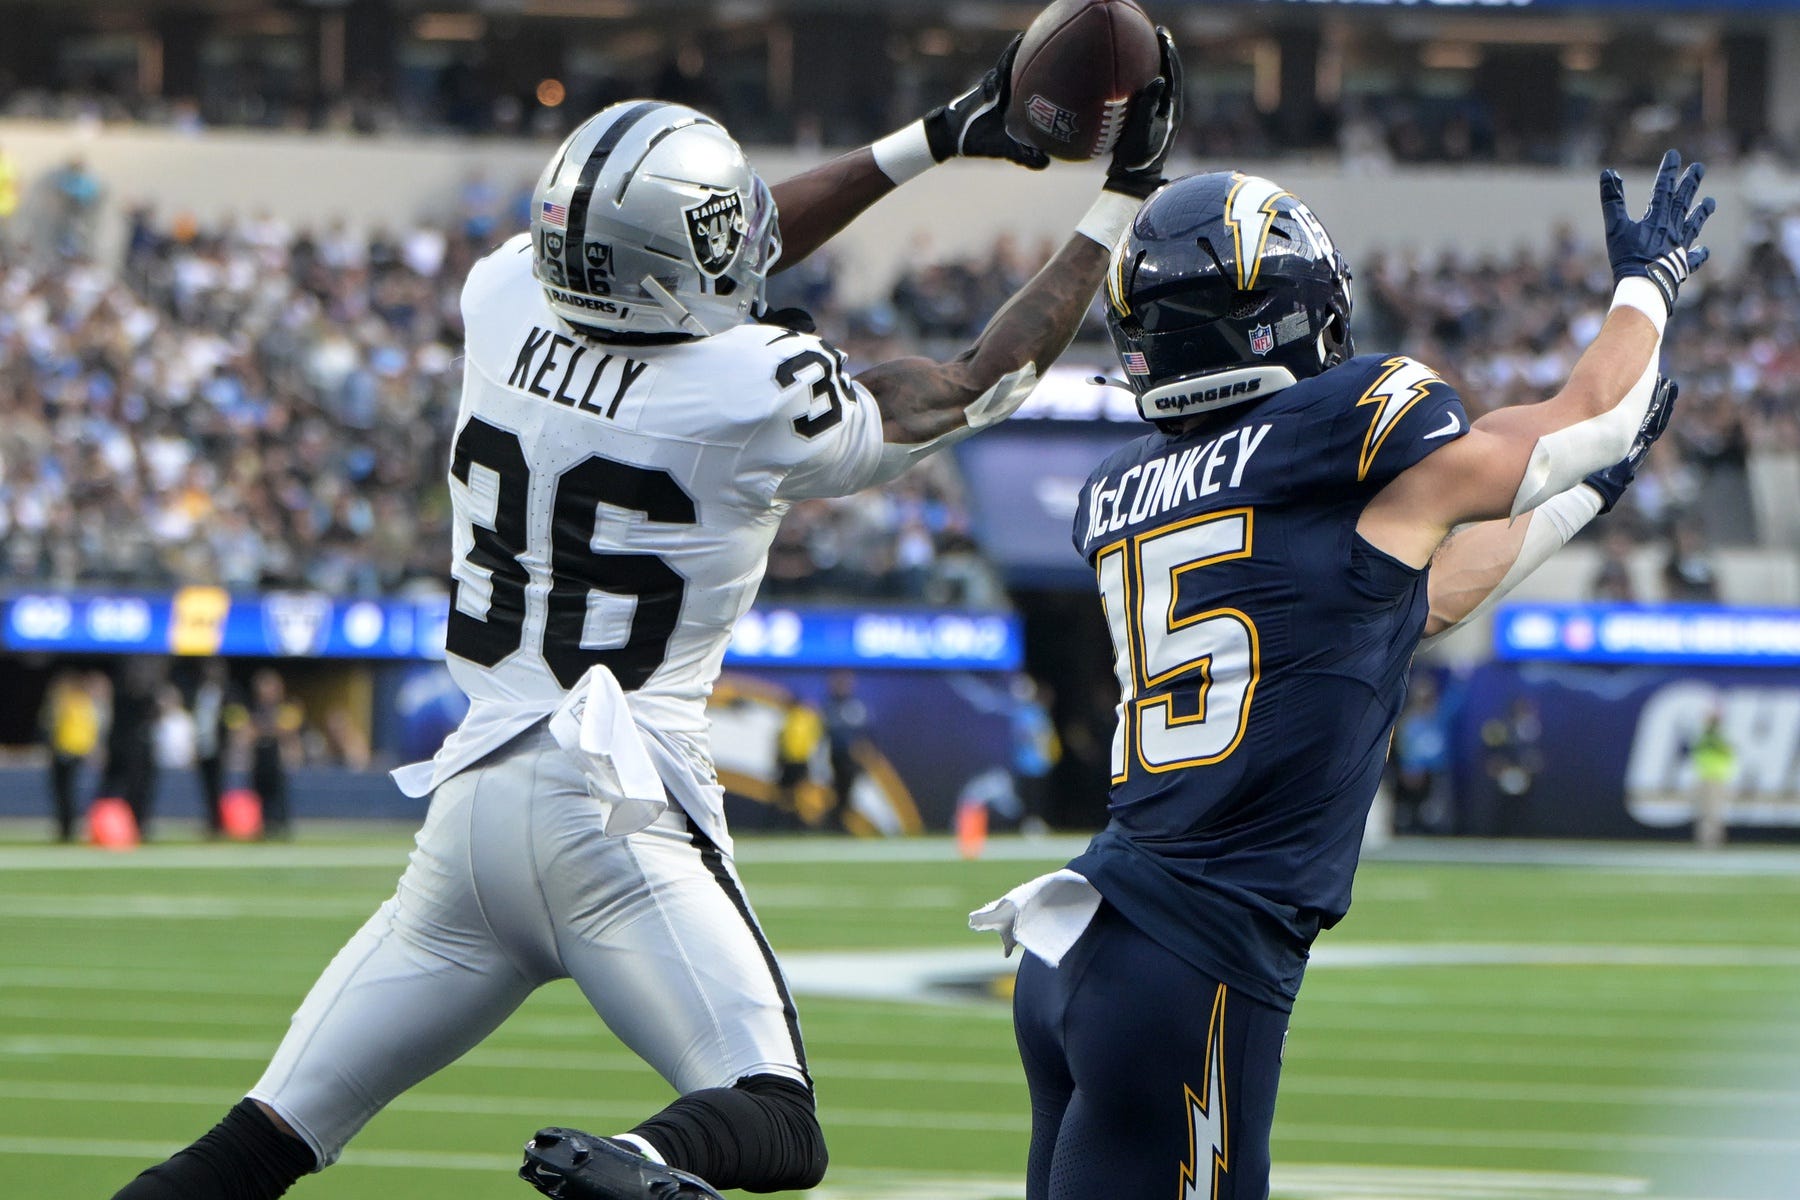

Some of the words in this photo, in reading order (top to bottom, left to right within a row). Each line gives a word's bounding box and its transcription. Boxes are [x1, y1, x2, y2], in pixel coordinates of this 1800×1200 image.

[692, 195, 737, 221] RAIDERS
[587, 246, 606, 260] AL
[551, 289, 617, 314] RAIDERS
[1253, 336, 1272, 351] NFL
[509, 326, 648, 420] KELLY
[1154, 377, 1262, 413] CHARGERS
[445, 415, 697, 693] 36
[1097, 506, 1260, 785] 15
